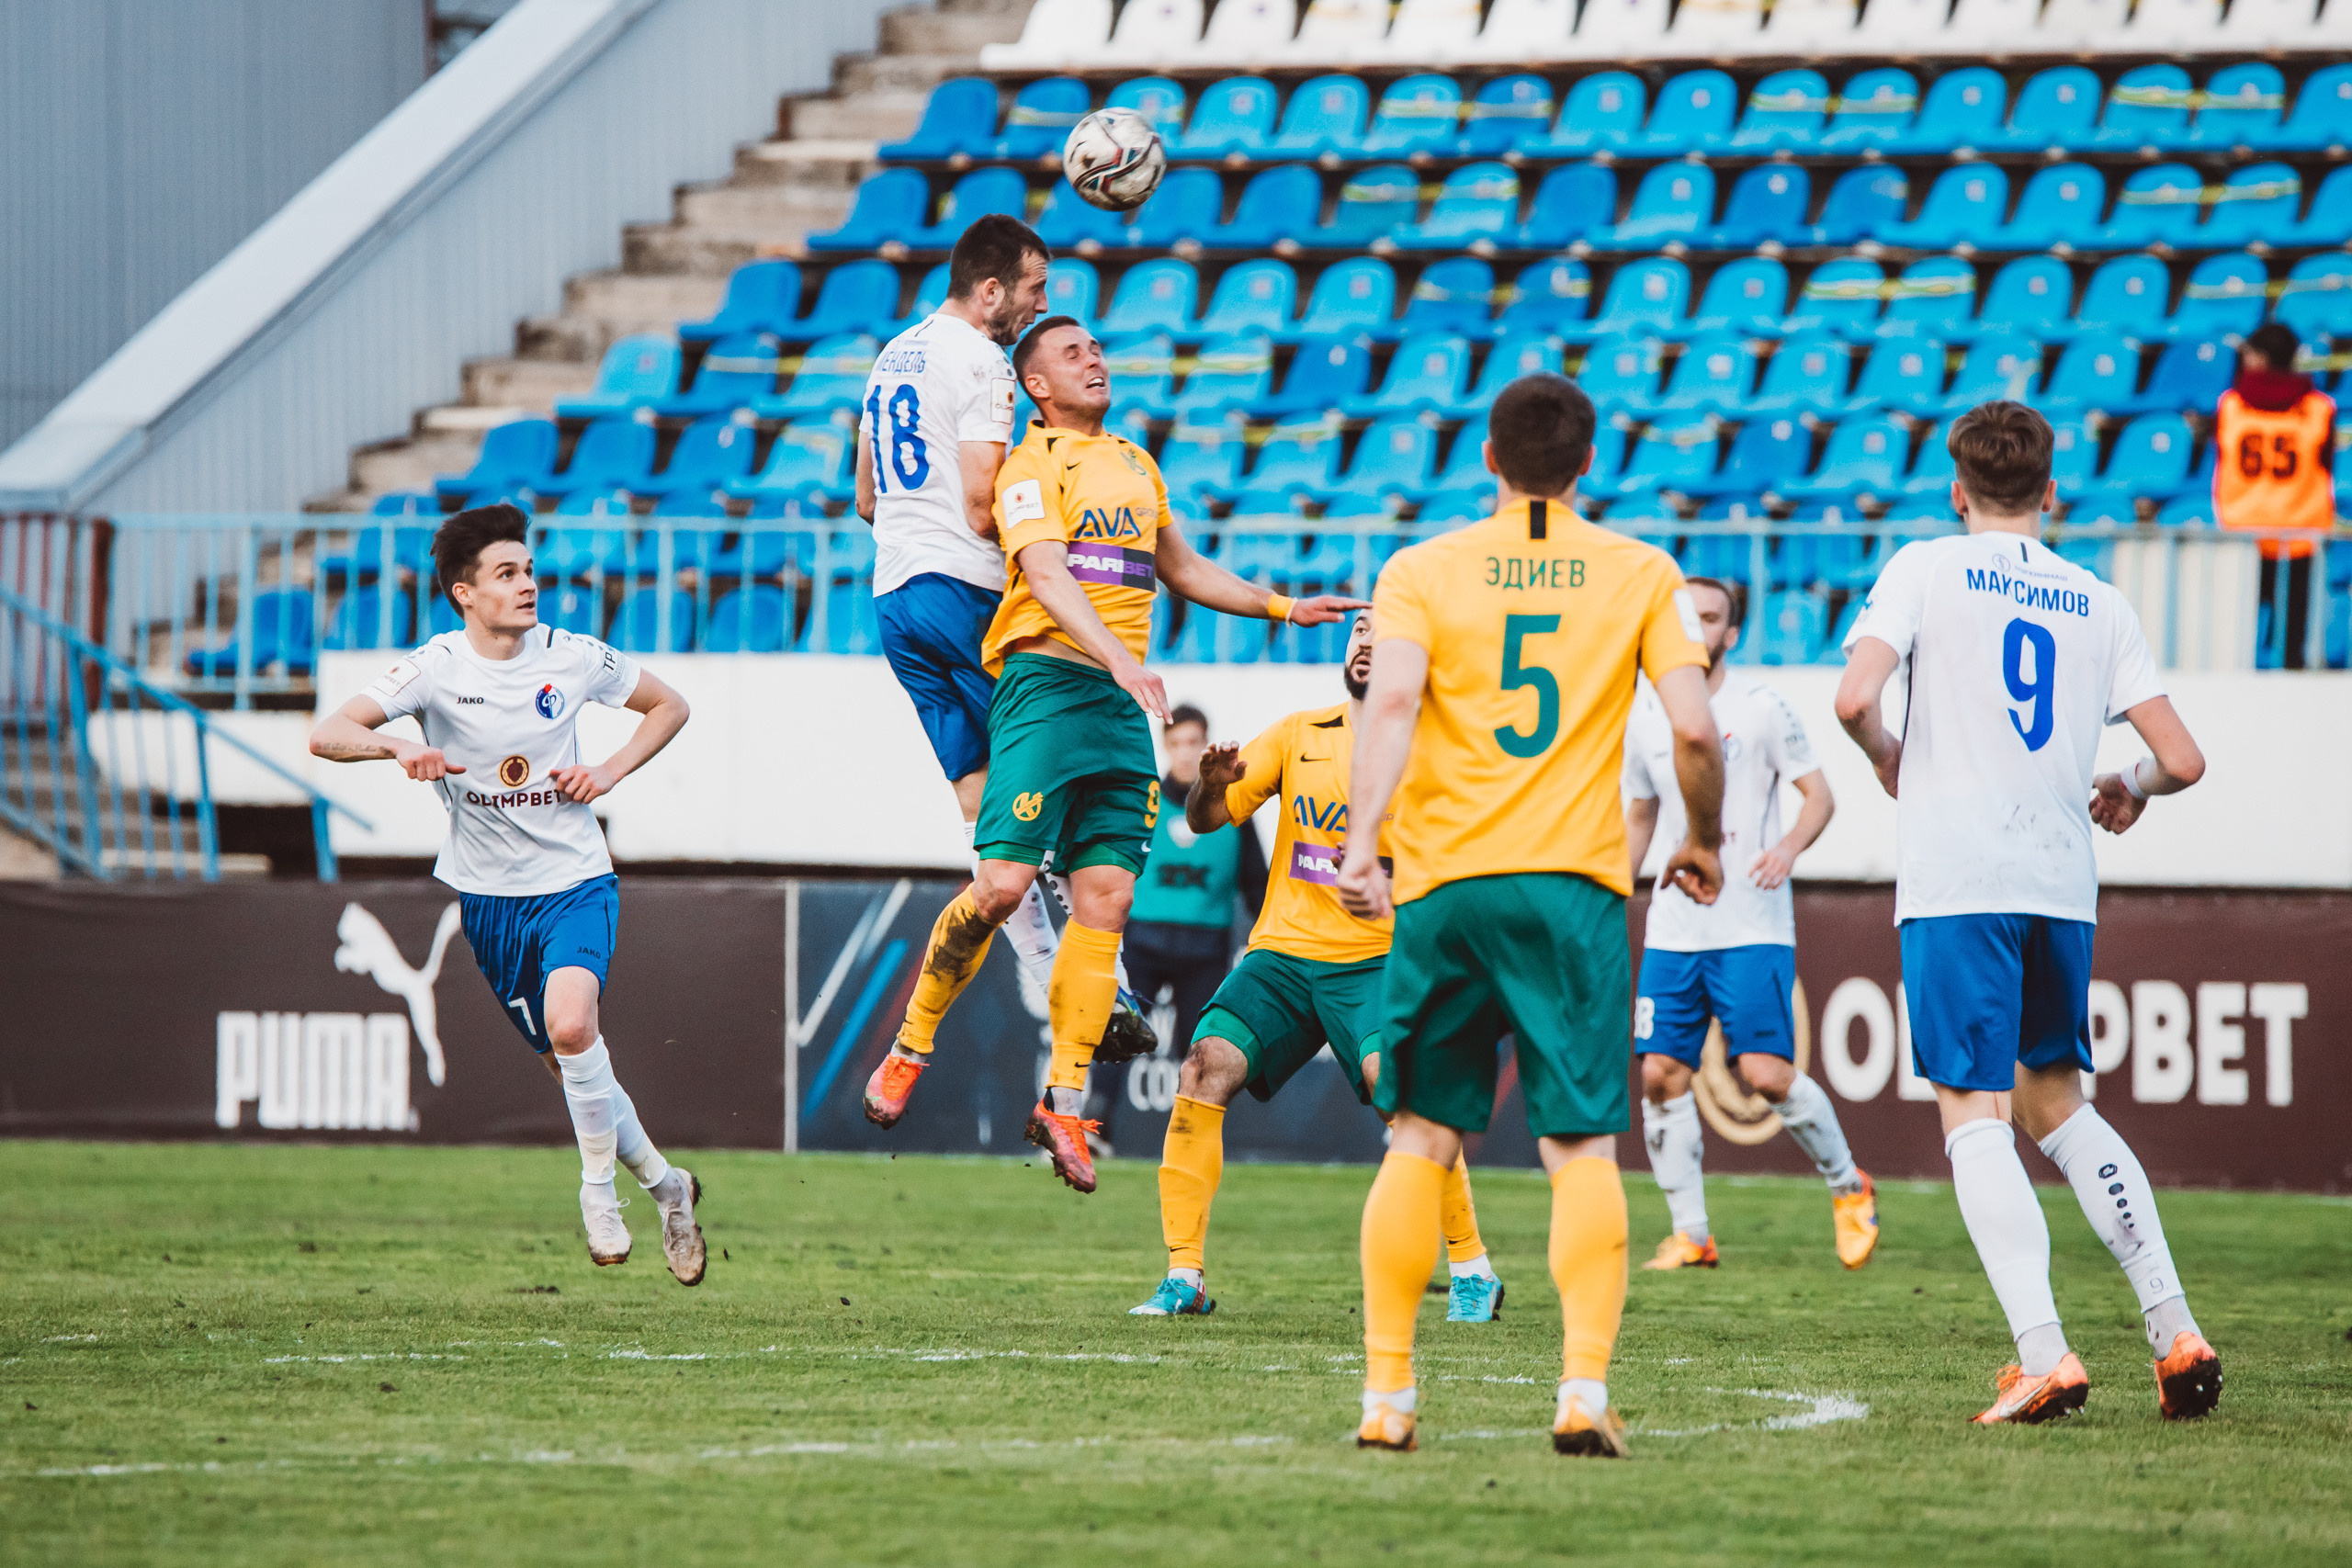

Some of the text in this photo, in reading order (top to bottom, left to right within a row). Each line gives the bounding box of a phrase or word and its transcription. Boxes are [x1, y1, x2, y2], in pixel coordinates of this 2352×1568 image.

[866, 383, 930, 494] 18
[2240, 433, 2297, 479] 65
[1073, 506, 1141, 539] AVA
[1066, 553, 1154, 579] PARIBET
[1485, 557, 1586, 591] ЭДИЕВ
[1965, 568, 2089, 617] МАКСИМОВ
[456, 696, 485, 705] JAKO
[1494, 614, 1562, 759] 5
[2002, 616, 2056, 752] 9
[466, 789, 561, 808] OLIMPBET
[576, 945, 602, 960] JAKO
[507, 996, 537, 1036] 7
[1821, 976, 2309, 1107] OLPBET
[215, 1010, 411, 1132] PUMA
